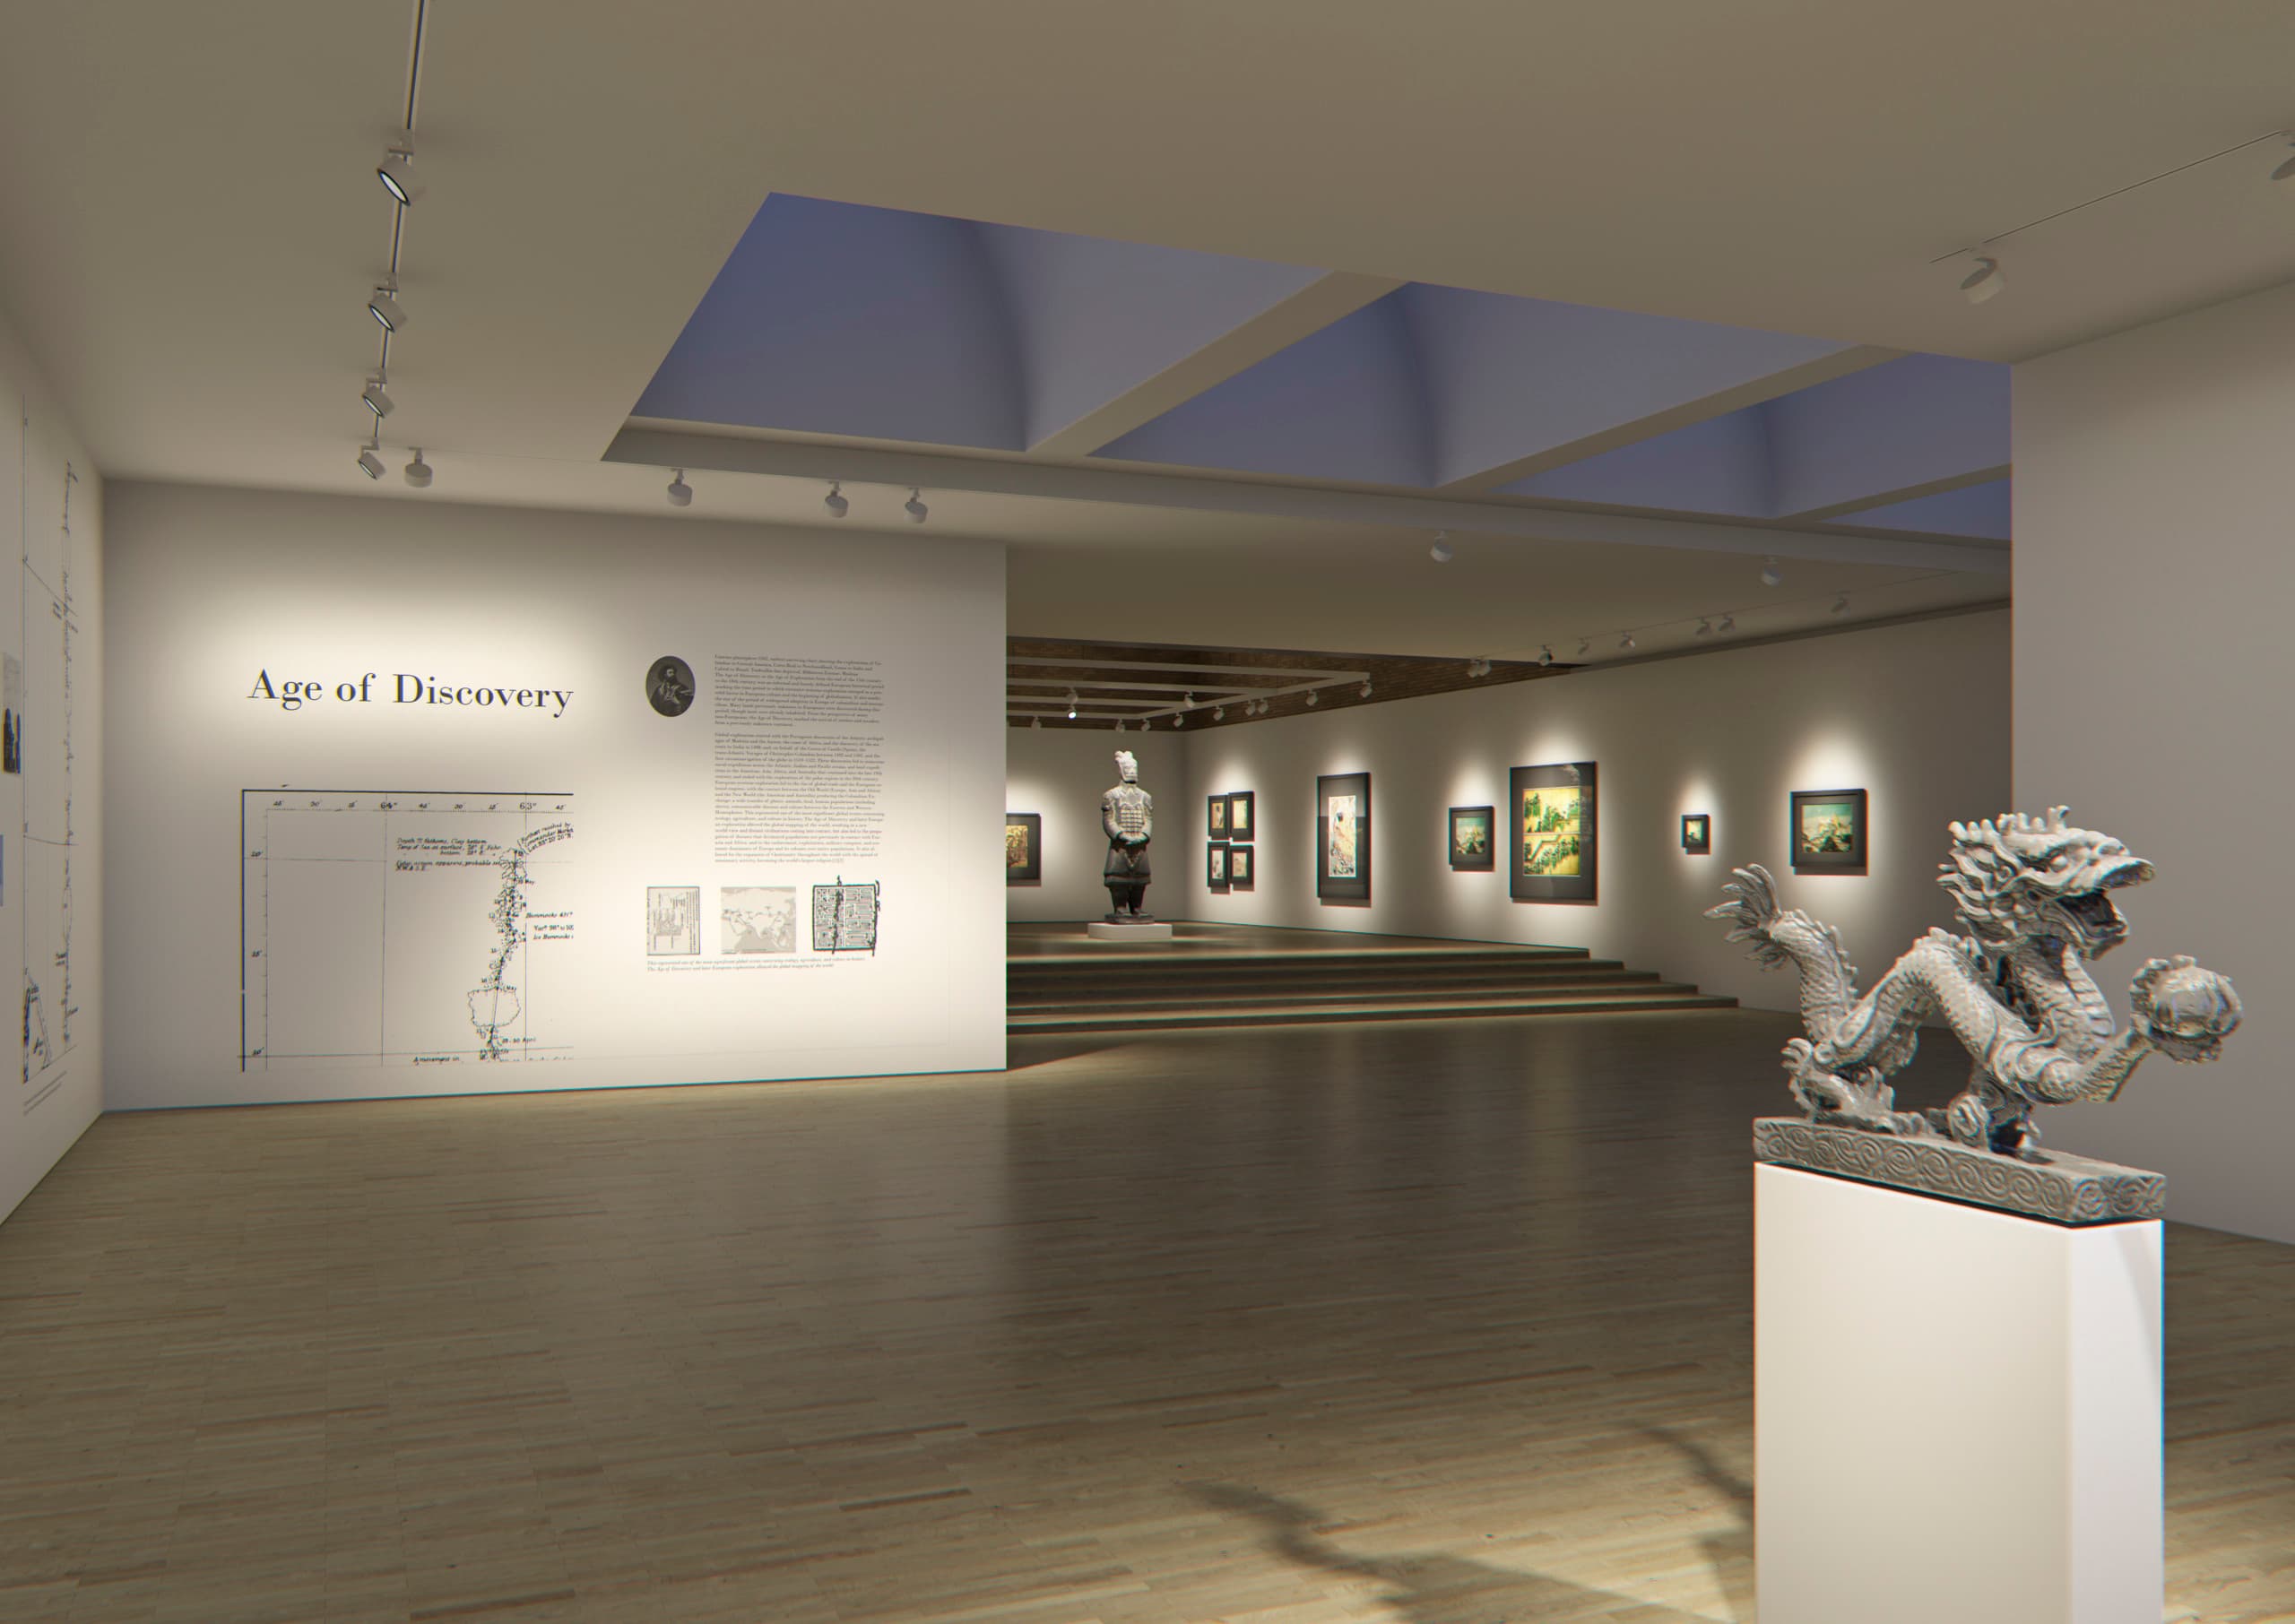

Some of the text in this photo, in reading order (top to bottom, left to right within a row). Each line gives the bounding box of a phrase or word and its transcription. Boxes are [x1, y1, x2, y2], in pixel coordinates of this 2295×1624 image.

[247, 668, 575, 719] Age of Discovery
